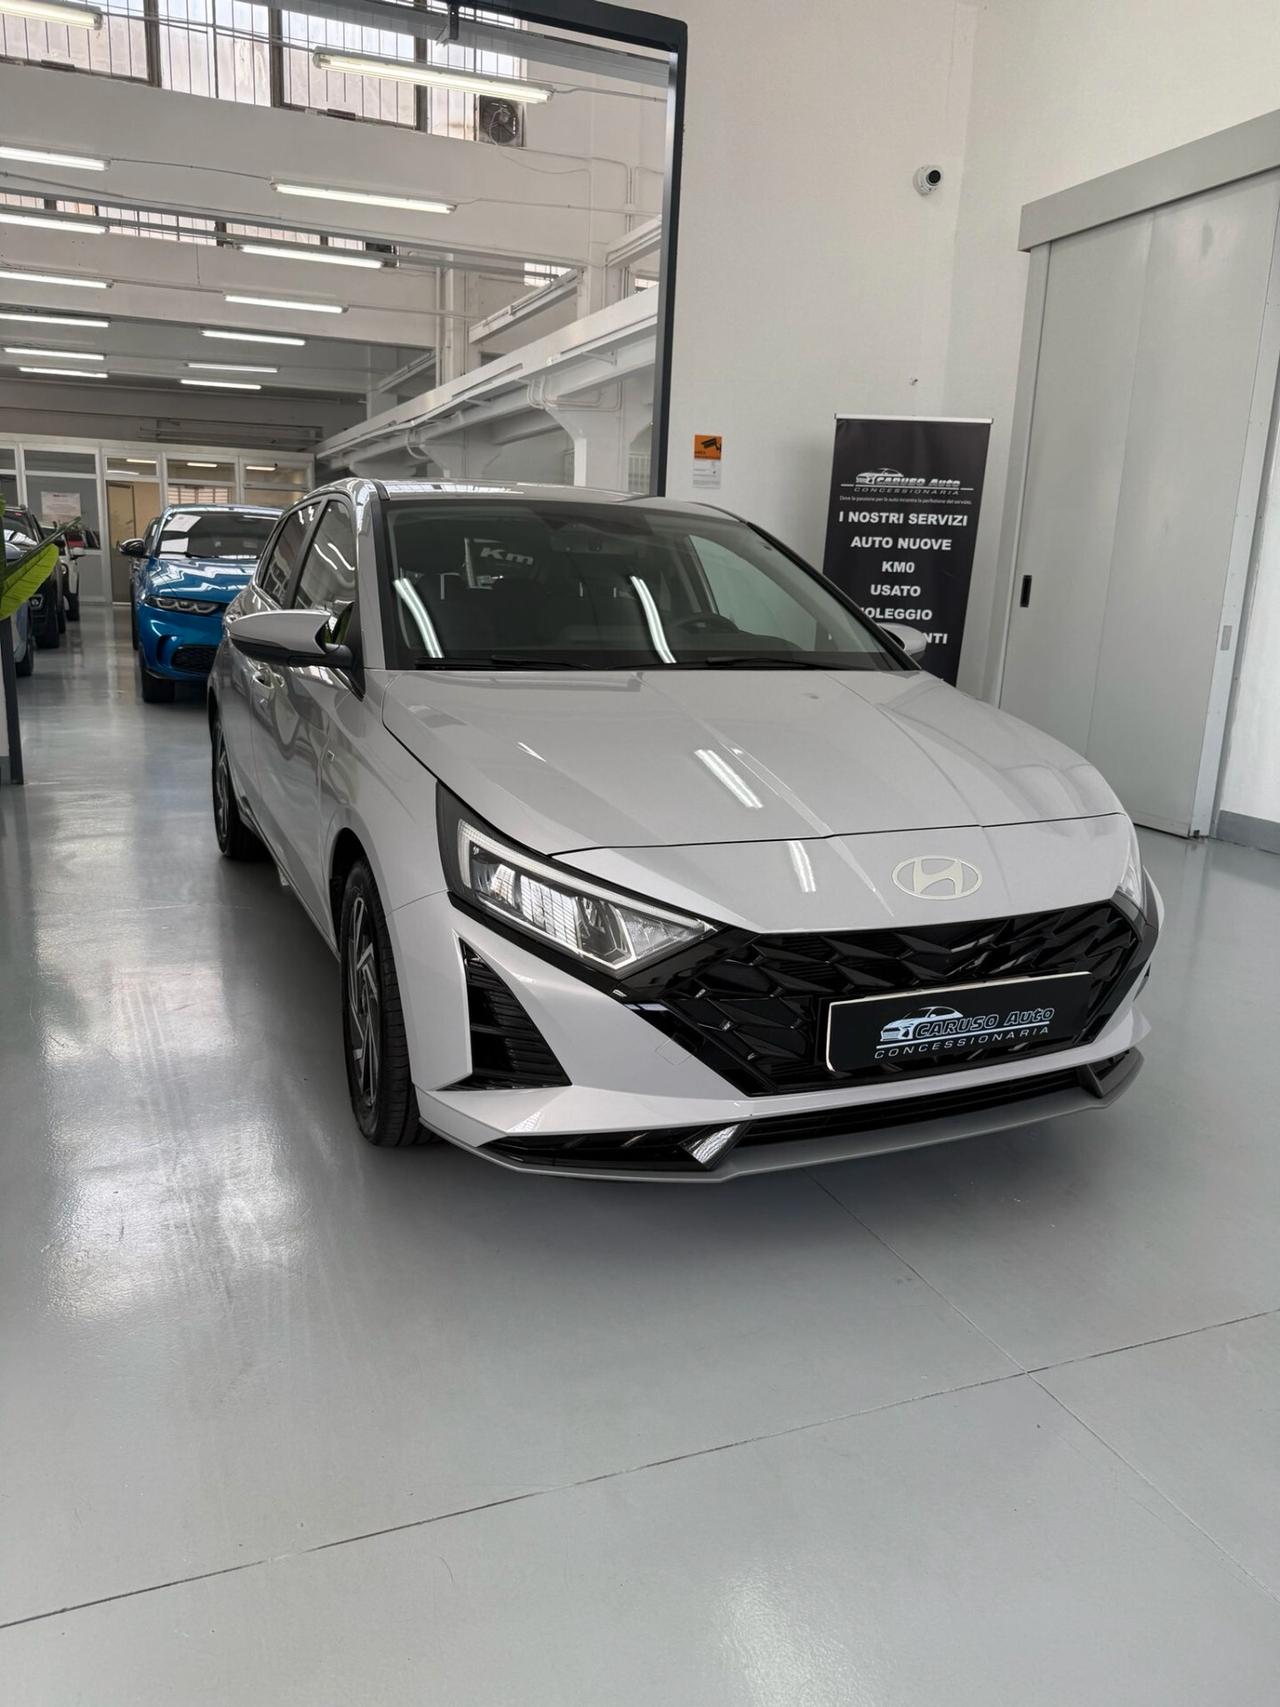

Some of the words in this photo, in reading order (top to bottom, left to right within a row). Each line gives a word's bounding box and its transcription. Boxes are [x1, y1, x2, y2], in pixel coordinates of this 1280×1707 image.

[853, 488, 960, 496] CONCESSIONARIA
[839, 511, 844, 522] I
[848, 511, 904, 524] NOSTRI
[908, 513, 968, 526] SERVIZI
[850, 536, 893, 549] AUTO
[897, 537, 952, 551] NUOVE
[870, 584, 921, 597] USATO
[860, 607, 933, 620] OLEGGIO
[915, 1013, 1000, 1039] CARUSO
[874, 1026, 1049, 1060] CONCESSIONARIA
